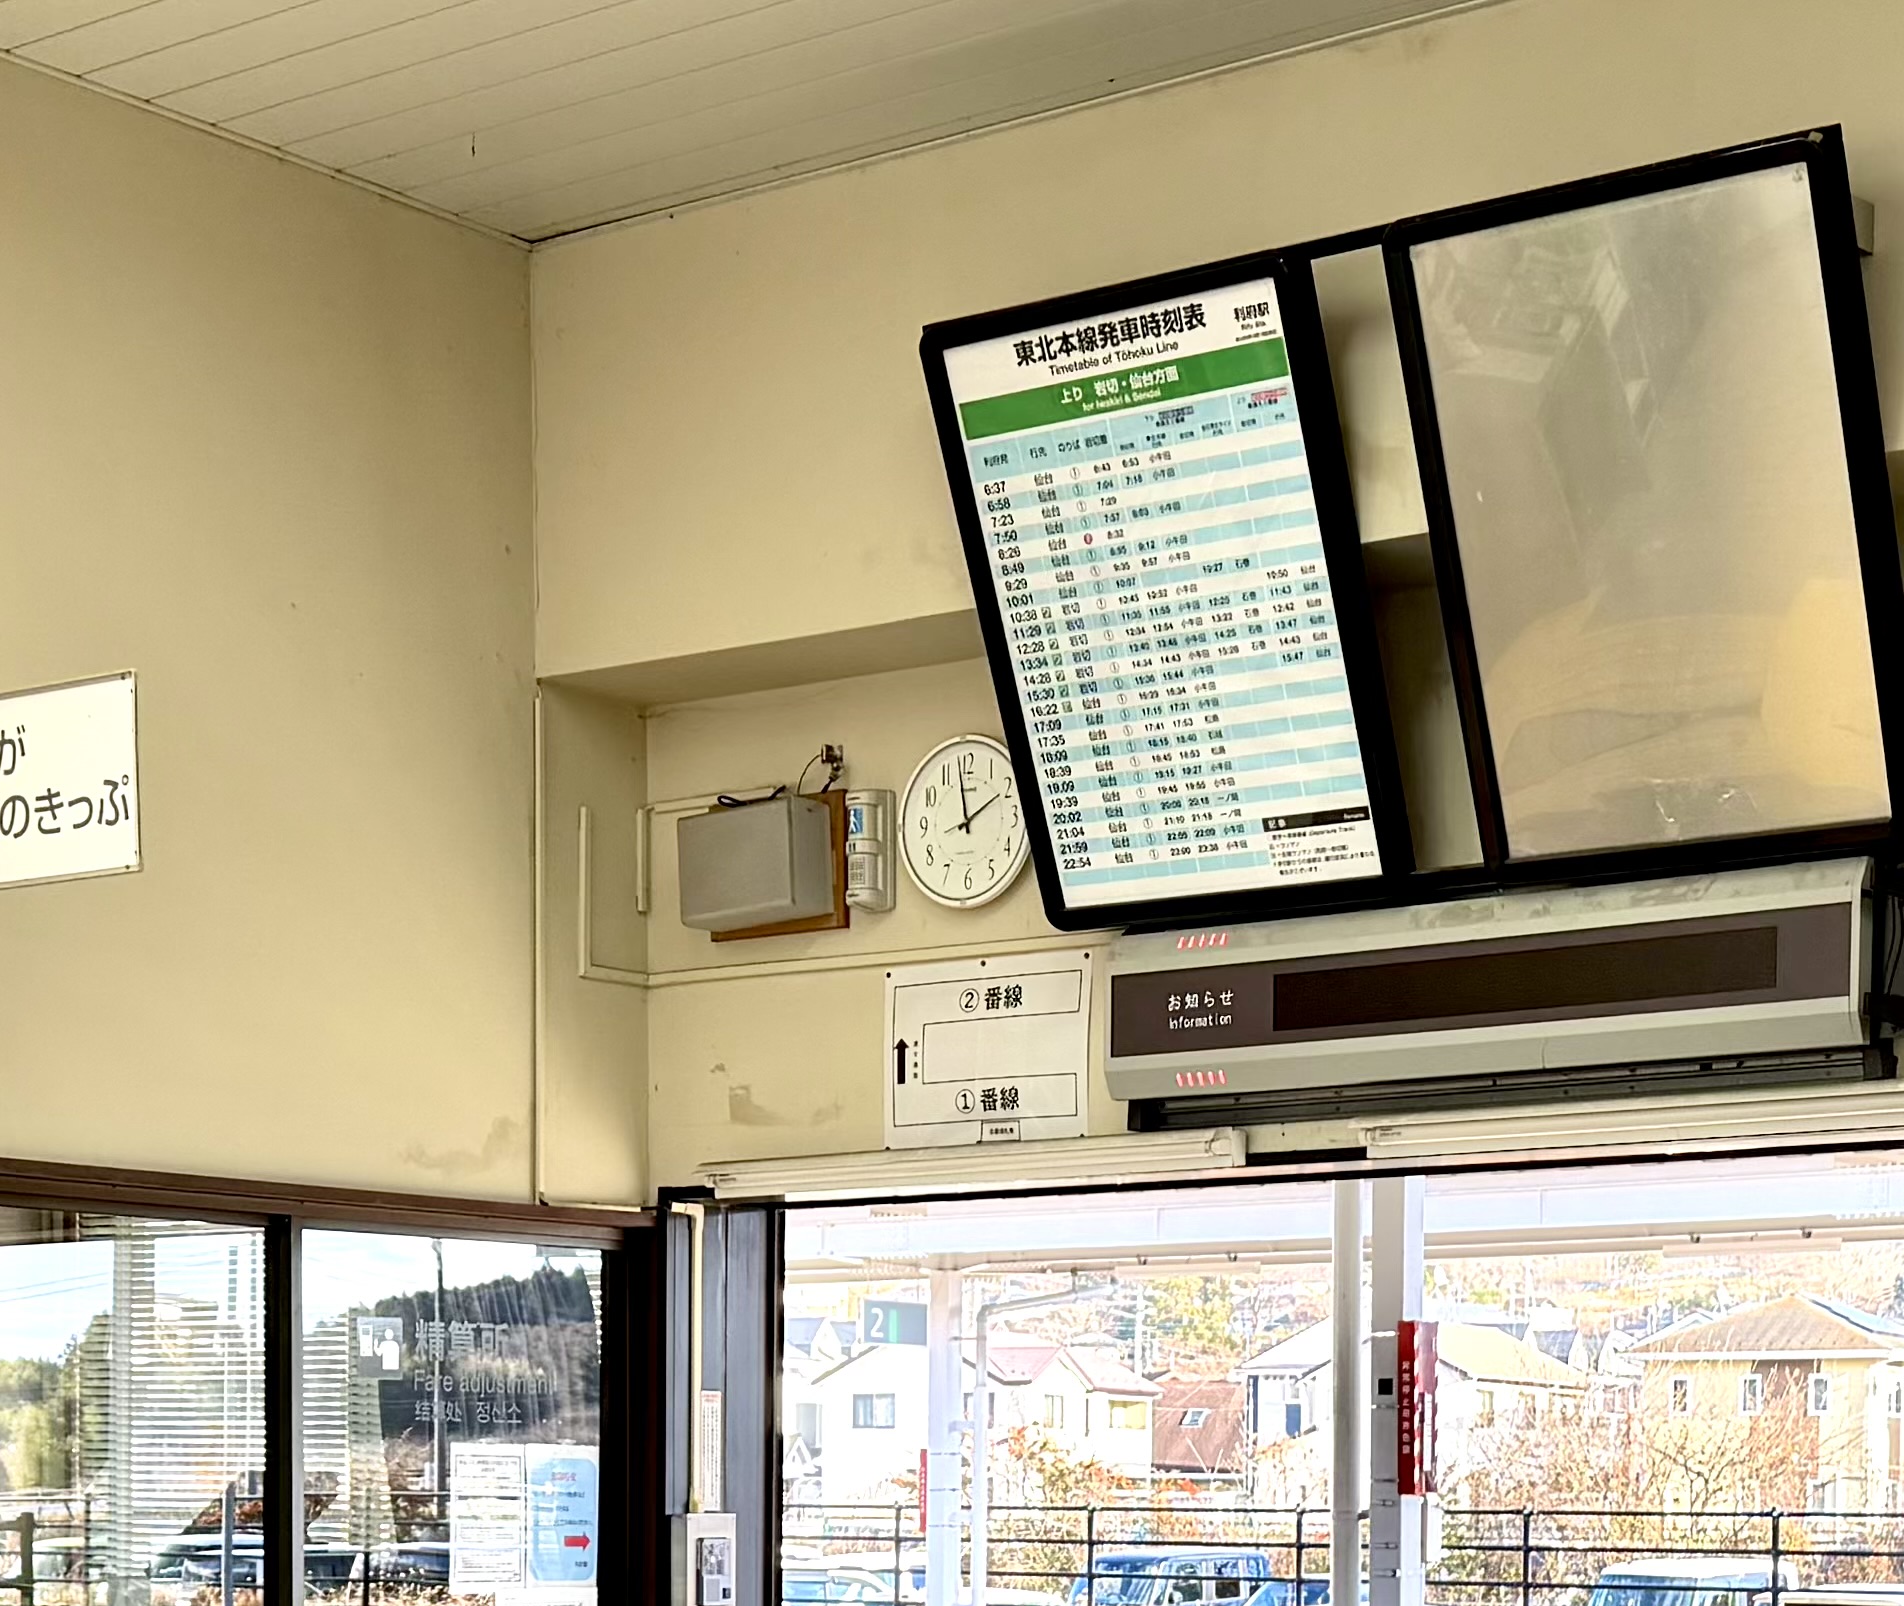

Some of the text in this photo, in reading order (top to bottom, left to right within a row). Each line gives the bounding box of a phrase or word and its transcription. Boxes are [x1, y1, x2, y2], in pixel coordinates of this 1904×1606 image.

[1012, 301, 1207, 367] 東北本線発車時刻表
[1048, 355, 1100, 376] Timetable
[1100, 352, 1112, 365] of
[1155, 338, 1179, 354] Line
[1058, 364, 1179, 404] 上り 岩切・仙台方面
[982, 480, 1007, 496] 6:37
[986, 496, 1011, 512] 6:58
[990, 513, 1014, 528] 7:23
[993, 529, 1018, 544] 7:50
[1005, 592, 1035, 608] 10:01
[1015, 640, 1045, 655] 12:28
[1018, 656, 1049, 671] 13:34
[1022, 671, 1052, 687] 14:28
[1035, 734, 1066, 748] 17:35
[942, 763, 951, 786] 11
[963, 752, 975, 775] 12
[925, 785, 937, 808] 10
[1004, 776, 1013, 799] 2
[1049, 795, 1079, 809] 19:39
[919, 816, 929, 839] 9
[1010, 804, 1019, 829] 3
[1052, 811, 1082, 824] 20:02
[1055, 826, 1085, 839] 21:04
[926, 844, 934, 867] 8
[1003, 836, 1011, 857] 4
[988, 859, 995, 881] 5
[1062, 856, 1092, 869] 22:54
[943, 864, 951, 887] 7
[964, 868, 972, 890] 6
[1168, 989, 1234, 1012] お知らせ
[1169, 1012, 1232, 1030] Information
[870, 1307, 884, 1339] 2
[413, 1369, 559, 1398] Fare adjustment
